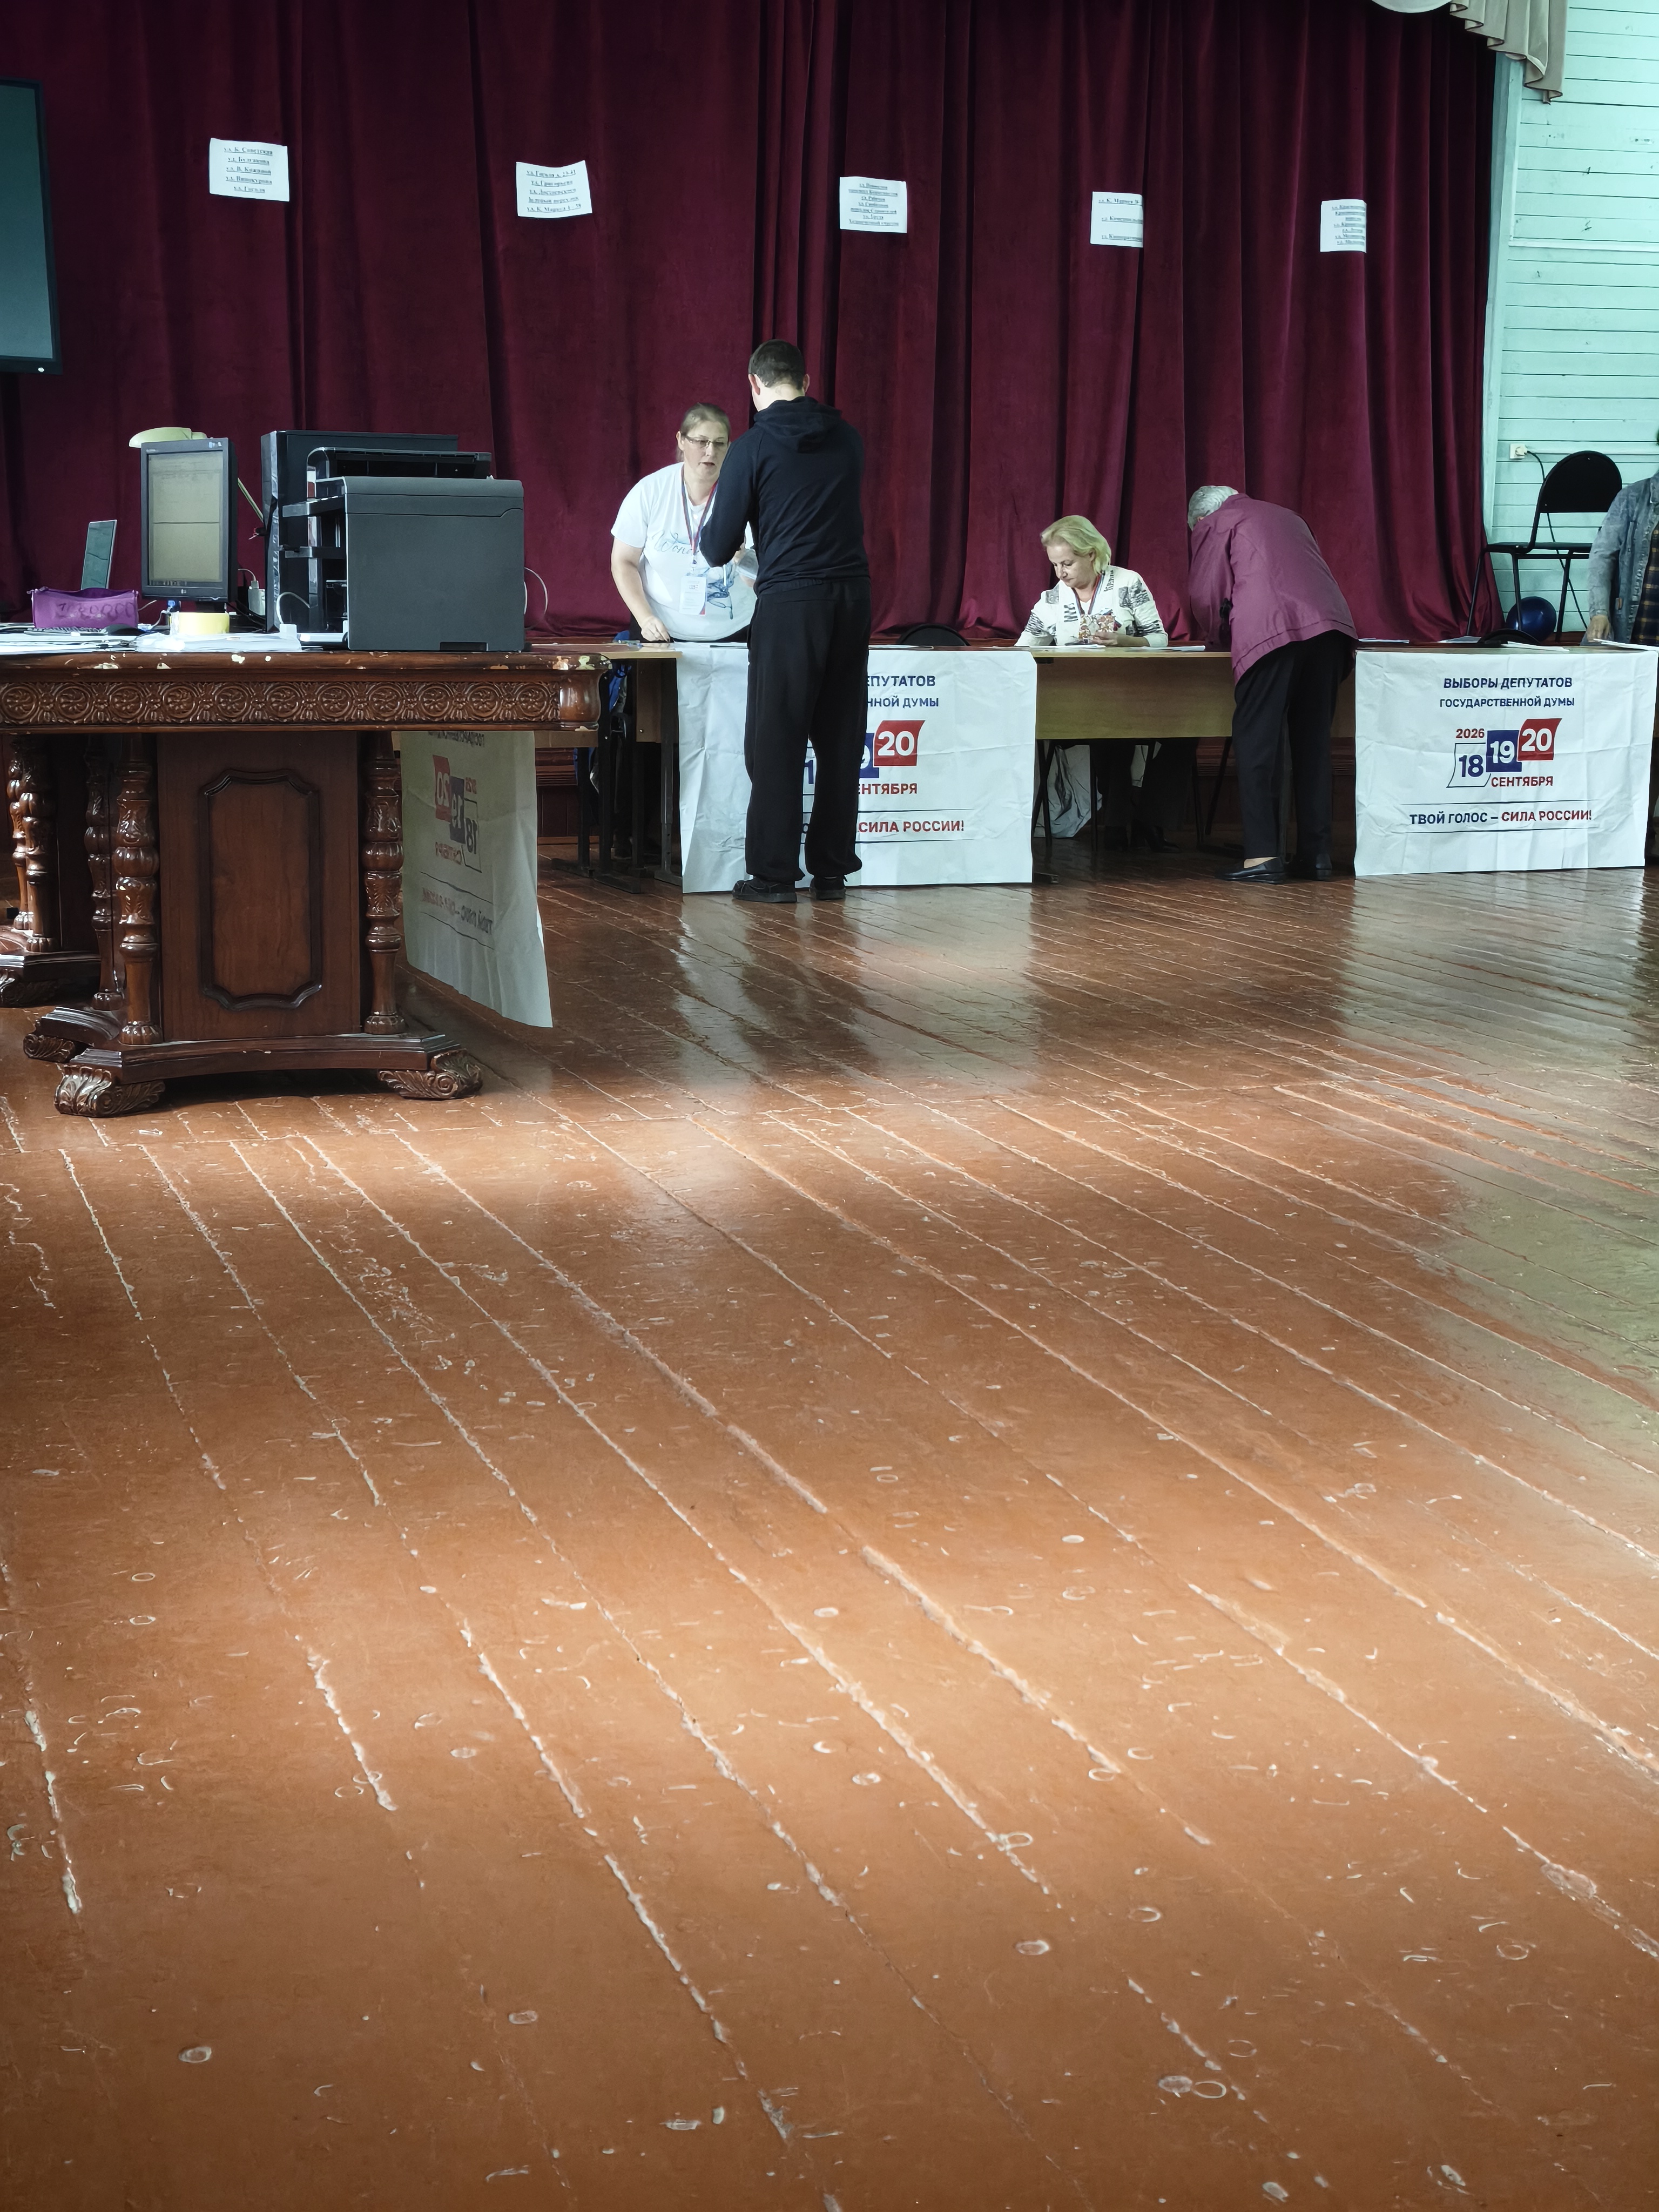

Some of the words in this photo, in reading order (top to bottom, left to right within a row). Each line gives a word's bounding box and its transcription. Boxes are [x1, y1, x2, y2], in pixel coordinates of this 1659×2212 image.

[867, 675, 935, 686] ПУТАТОВ
[1444, 678, 1498, 689] ВЫБОРЫ
[1500, 677, 1573, 690] ДЕПУТАТОВ
[902, 698, 939, 708] ДУМЫ
[1440, 696, 1541, 708] ГОСУДАРСТВЕННОЙ
[1543, 697, 1575, 707] ДУМЫ
[1455, 729, 1485, 739] 2026
[878, 731, 915, 756] 20
[1459, 754, 1484, 778] 18
[1490, 740, 1515, 764] 19
[1521, 728, 1553, 751] 20
[1491, 776, 1554, 787] СЕНТЯБРЯ
[859, 783, 918, 794] НТЯБРЯ
[1410, 811, 1445, 825] ТВОЙ
[1448, 812, 1488, 824] ГОЛОС
[1501, 811, 1536, 822] СИЛА
[1539, 810, 1592, 821] РОССИИ!
[858, 821, 899, 833] СИЛА
[903, 820, 964, 832] РОССИИ!
